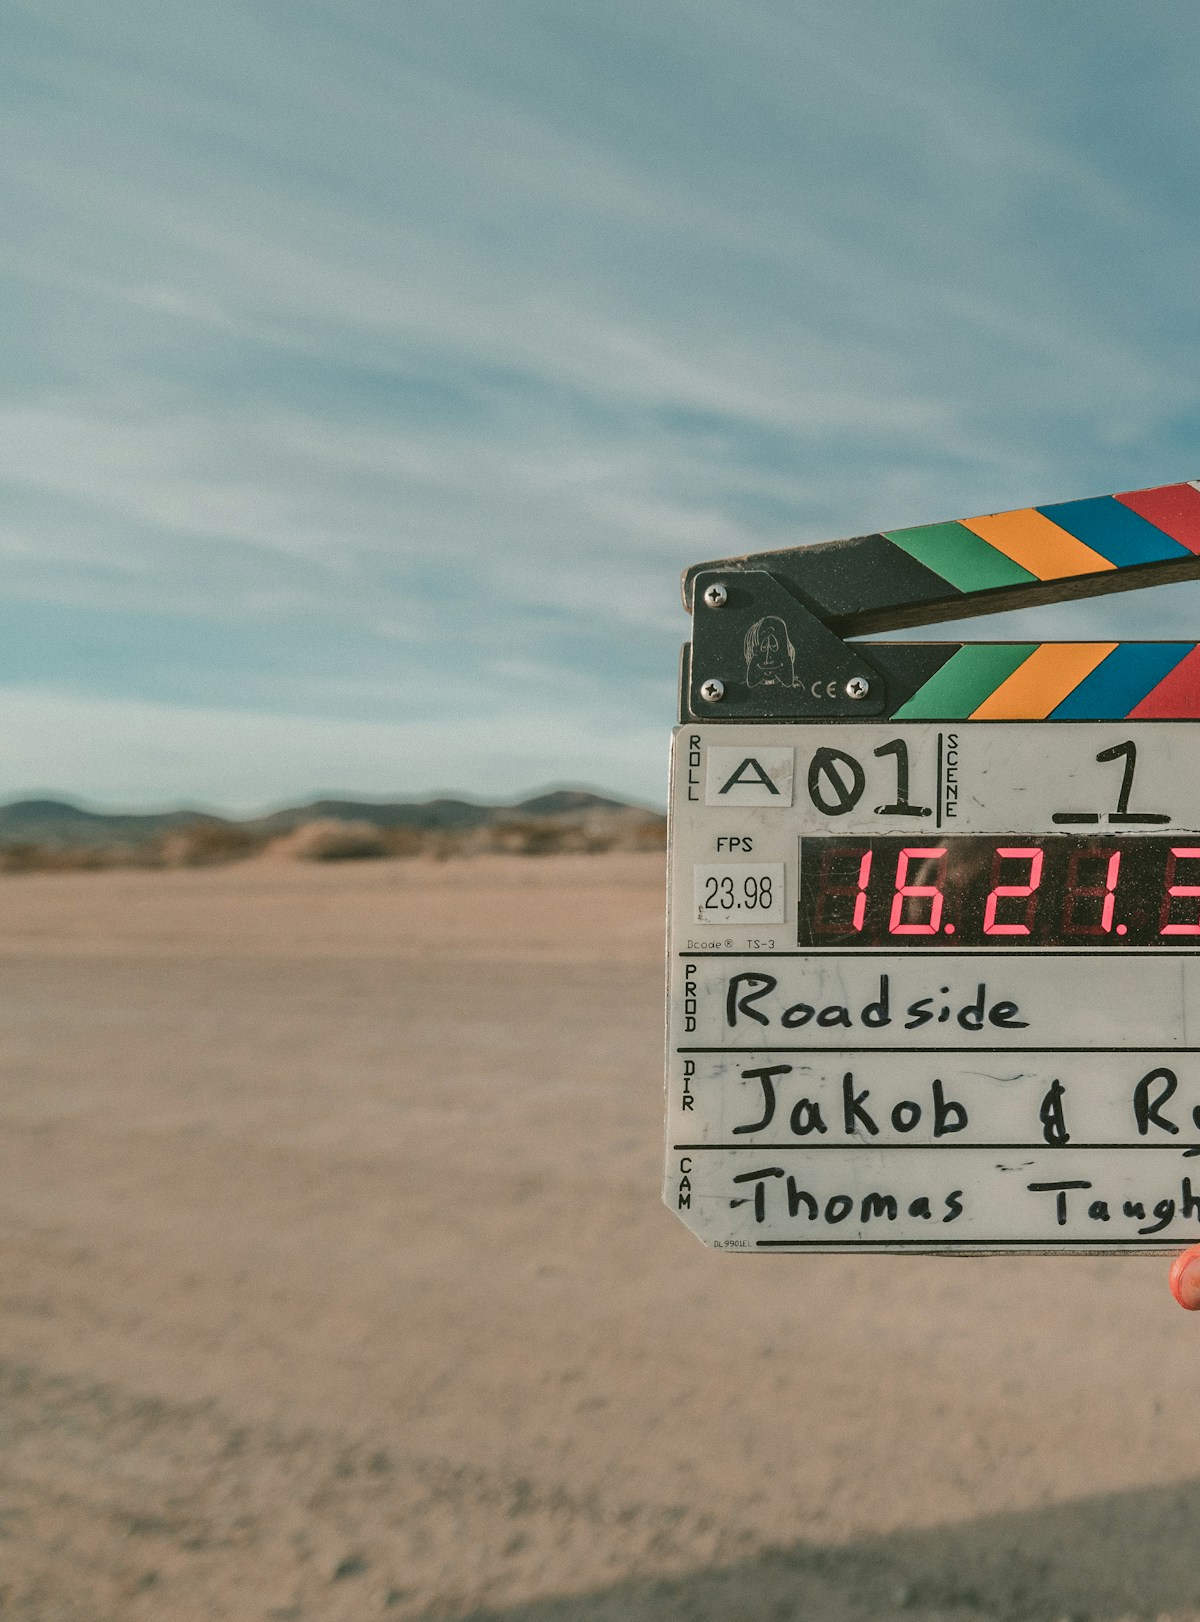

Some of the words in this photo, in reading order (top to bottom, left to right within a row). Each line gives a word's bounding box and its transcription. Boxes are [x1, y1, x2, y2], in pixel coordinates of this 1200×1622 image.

[689, 735, 700, 800] ROLL
[719, 758, 780, 794] A
[808, 739, 932, 817] 01
[946, 734, 958, 817] SCENE
[718, 837, 752, 852] FPS
[706, 877, 772, 909] 23.98
[747, 940, 774, 949] TS-3
[685, 965, 696, 1032] PROD
[727, 972, 1030, 1030] Roadside
[683, 1060, 695, 1110] DIR
[732, 1065, 968, 1138] Jakob
[679, 1158, 691, 1209] CAM
[730, 1167, 963, 1224] Thomas
